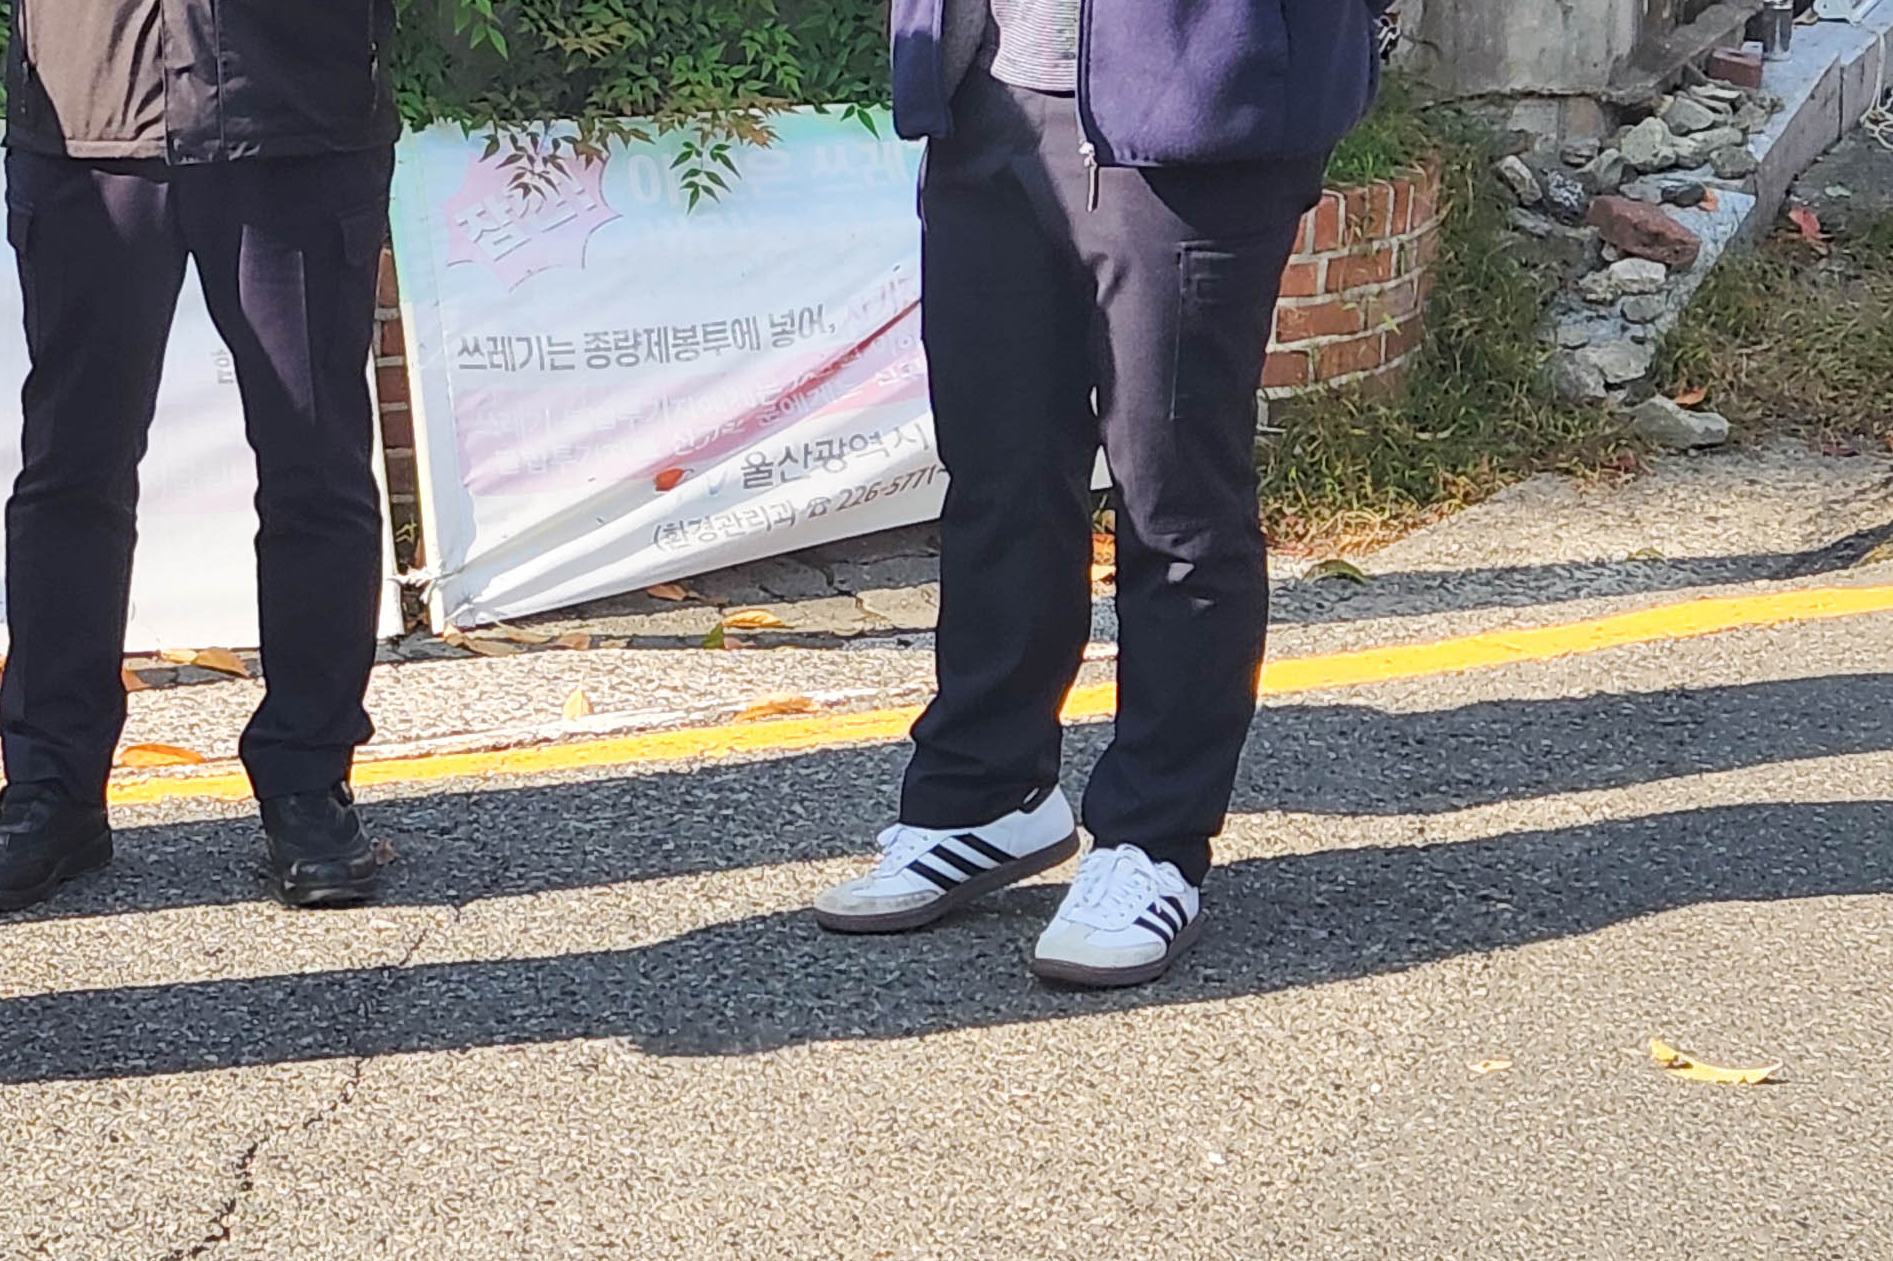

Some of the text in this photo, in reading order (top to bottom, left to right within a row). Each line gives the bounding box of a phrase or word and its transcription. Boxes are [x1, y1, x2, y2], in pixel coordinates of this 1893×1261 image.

[457, 335, 576, 372] 쓰레기는
[584, 315, 761, 369] 종량제봉투에
[768, 304, 837, 349] 넣어,
[740, 423, 930, 489] 울산광역시
